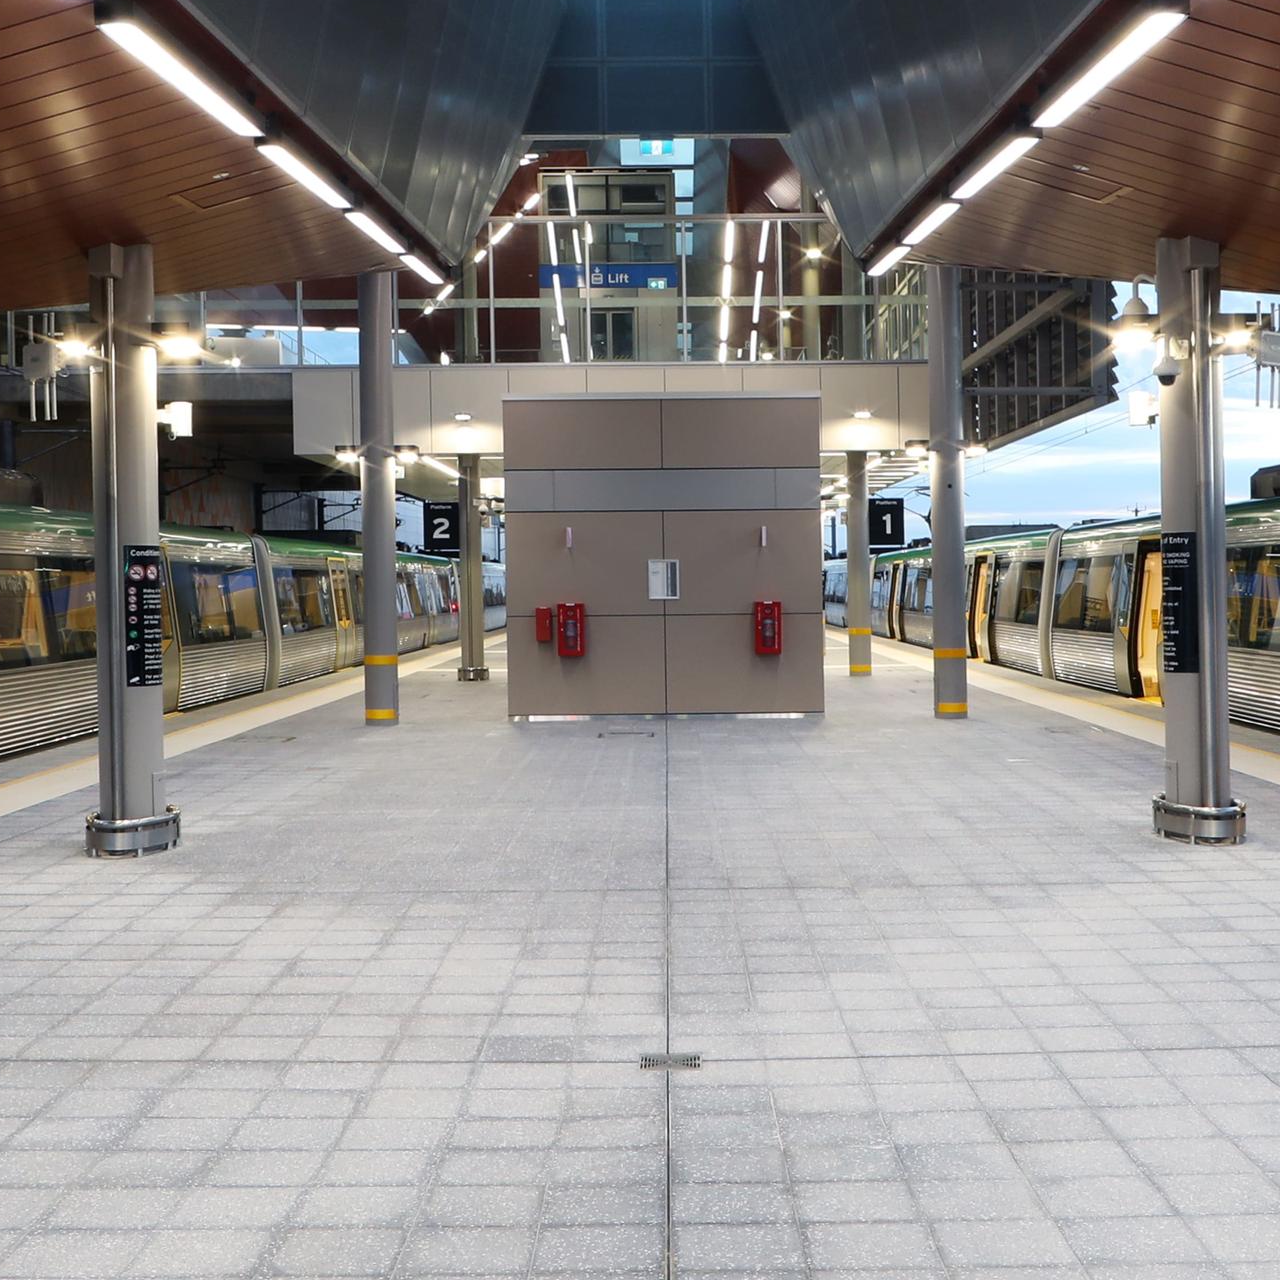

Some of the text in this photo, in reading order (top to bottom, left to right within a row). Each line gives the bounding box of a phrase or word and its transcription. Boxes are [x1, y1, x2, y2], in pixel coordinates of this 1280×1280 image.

[607, 273, 630, 284] Lift
[432, 517, 450, 539] 2
[882, 513, 892, 535] 1
[1169, 536, 1189, 545] Entry
